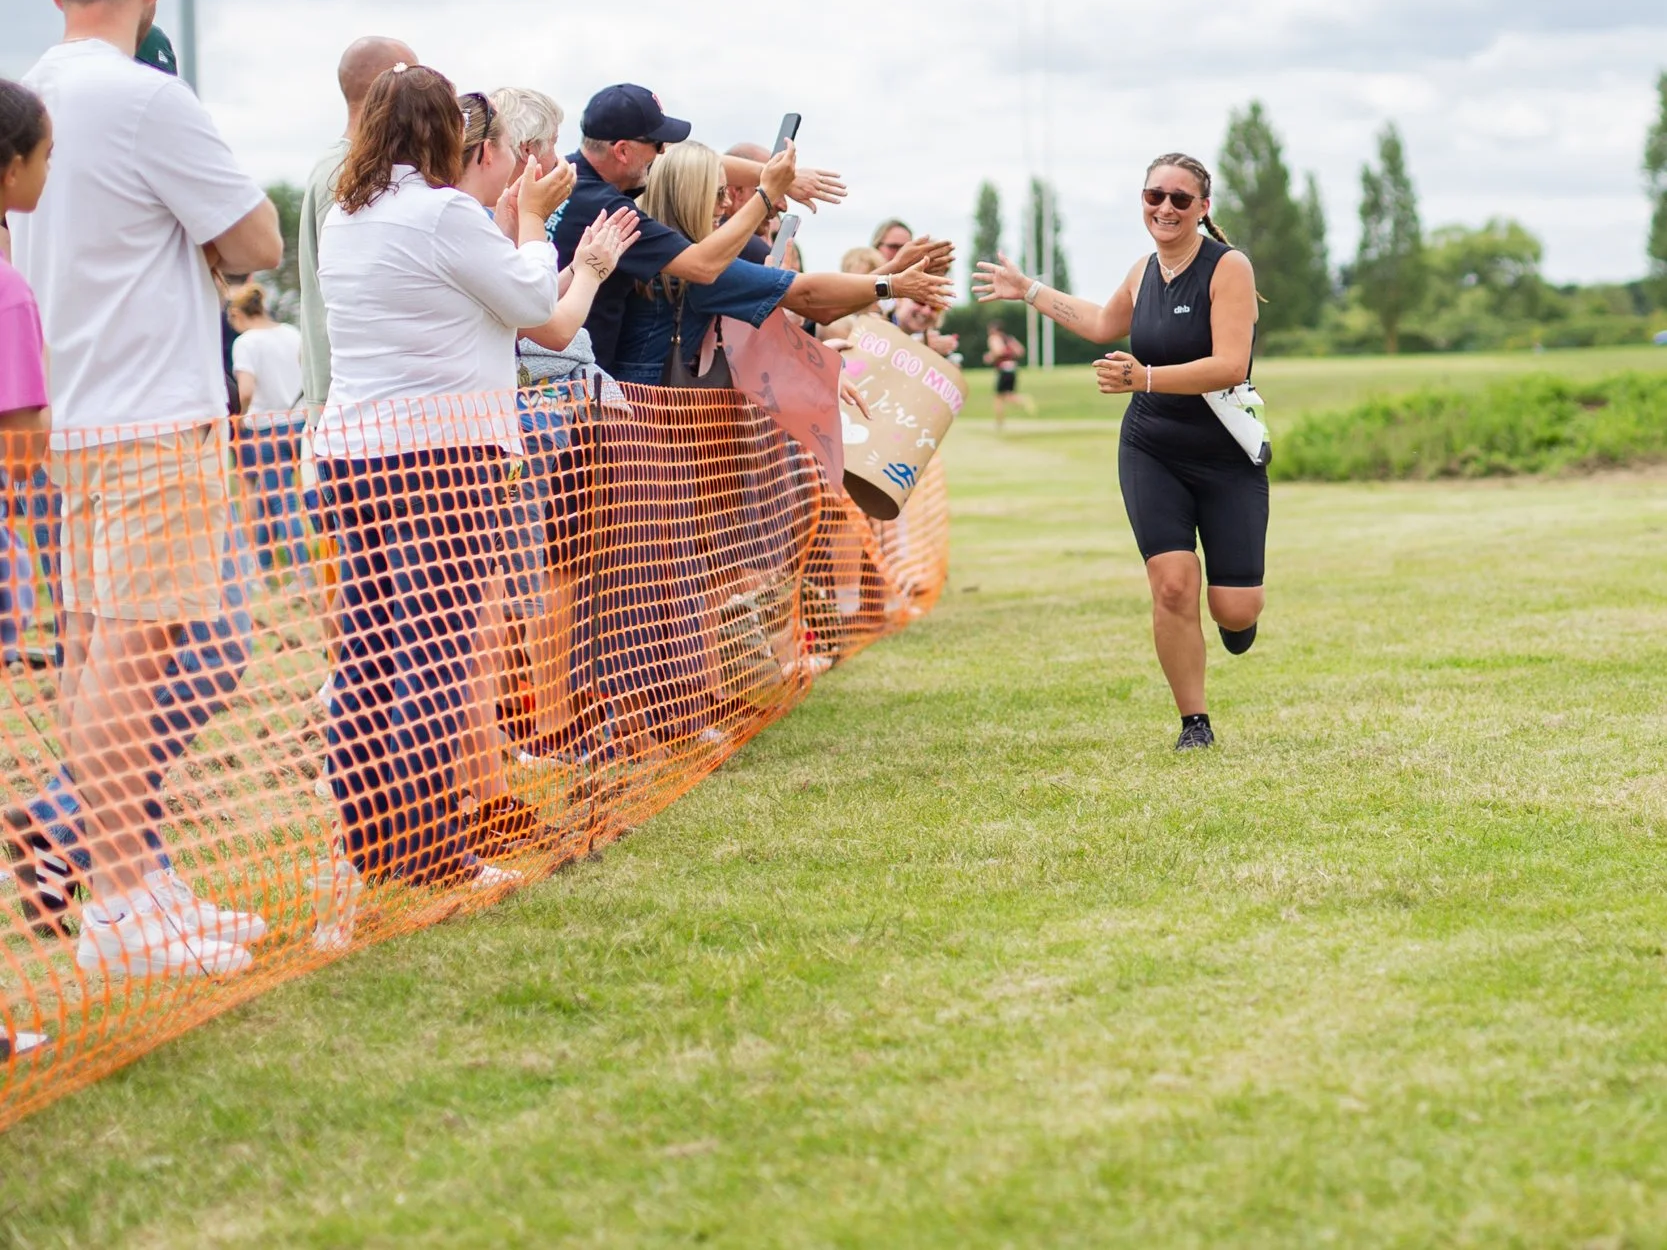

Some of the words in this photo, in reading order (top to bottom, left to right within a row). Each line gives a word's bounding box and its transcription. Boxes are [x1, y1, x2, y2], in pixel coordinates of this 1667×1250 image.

[585, 253, 609, 280] 372
[858, 332, 890, 357] GO
[891, 349, 922, 377] GO
